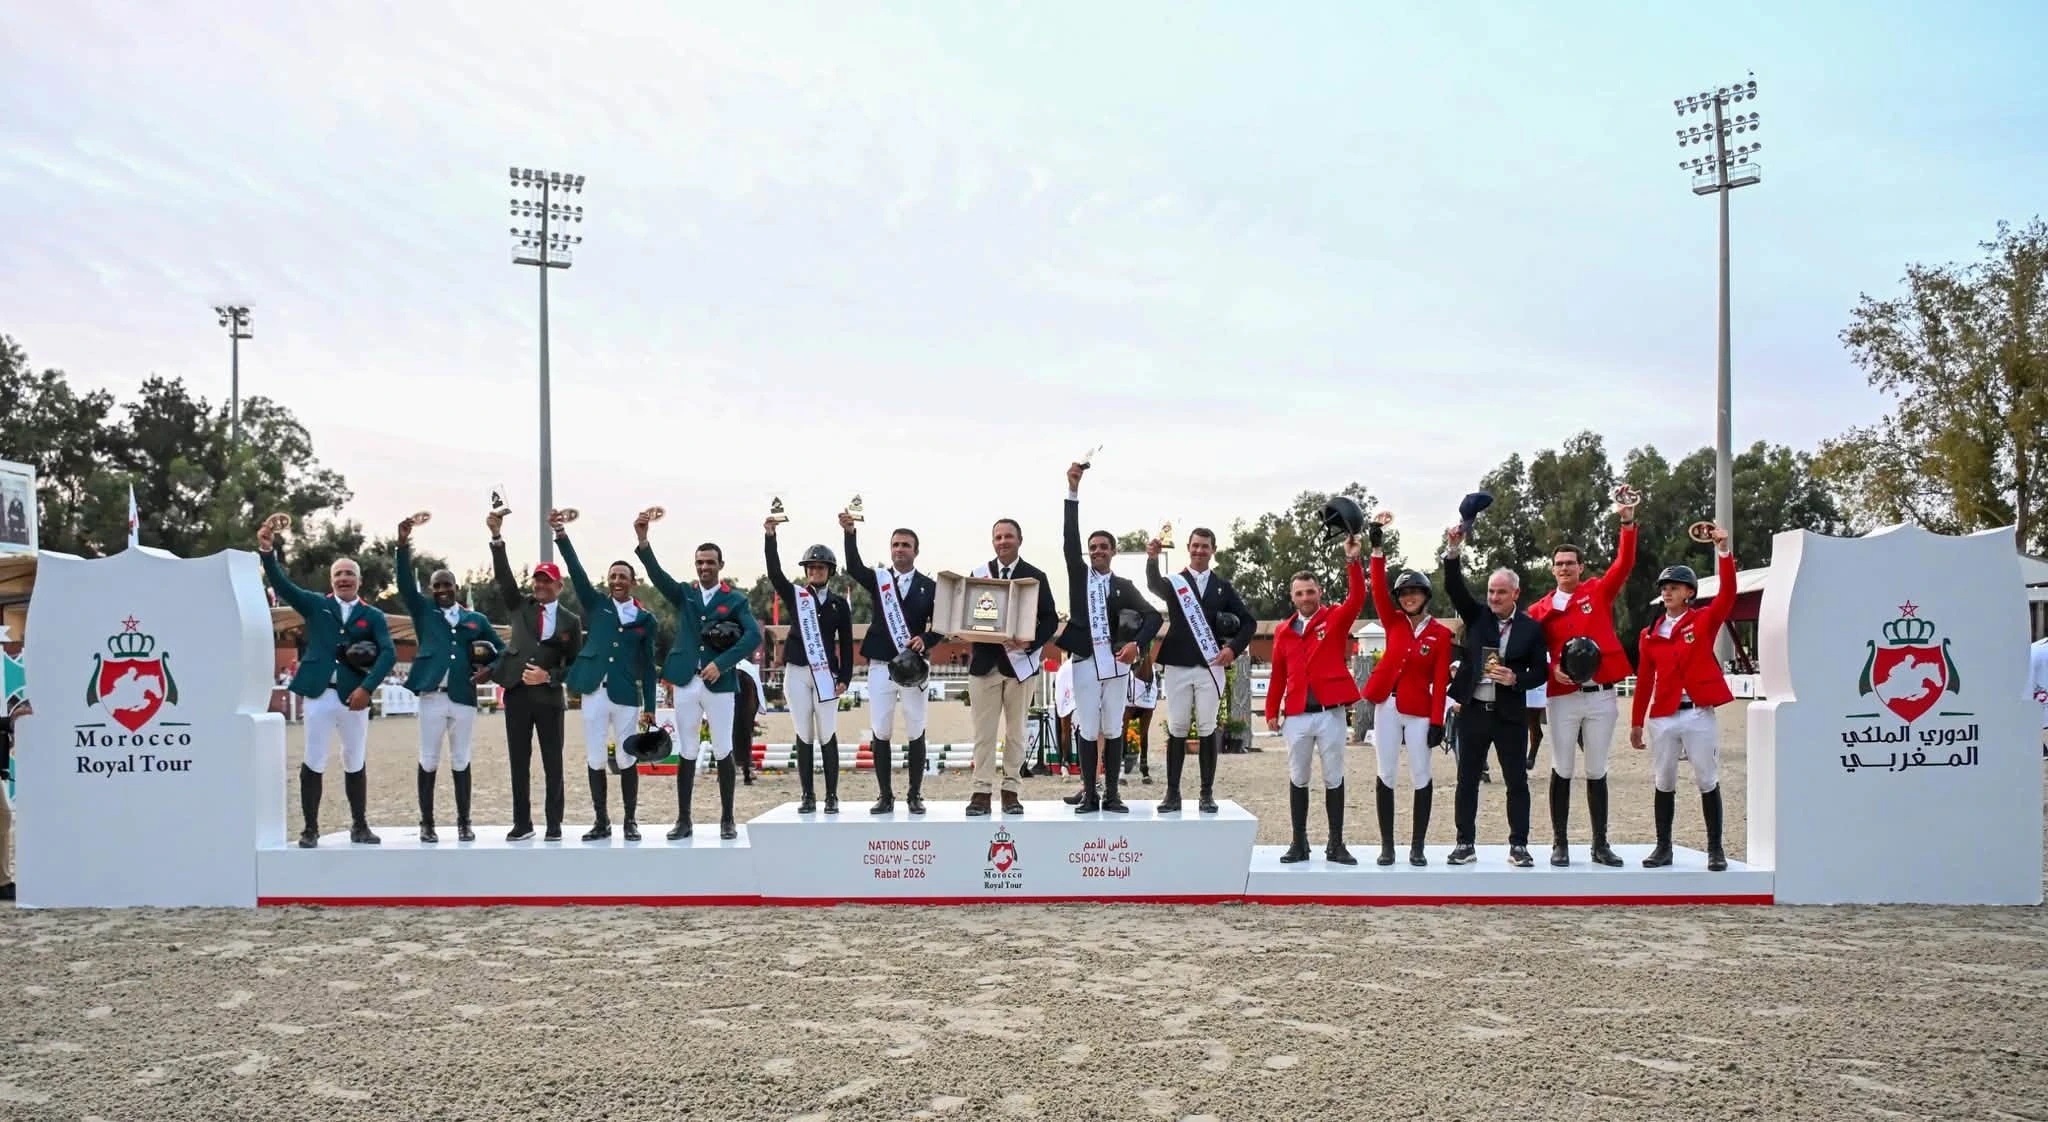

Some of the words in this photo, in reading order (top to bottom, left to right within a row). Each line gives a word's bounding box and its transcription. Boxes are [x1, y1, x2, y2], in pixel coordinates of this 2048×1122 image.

[1188, 614, 1204, 637] Nations
[1199, 638, 1210, 651] Cup
[895, 635, 904, 648] Cup
[807, 642, 816, 656] Cup
[75, 730, 191, 747] Morocco
[1841, 726, 1910, 747] الملكي
[1919, 724, 1978, 746] الدوري
[76, 755, 135, 778] Royal
[140, 755, 192, 772] Tour
[868, 841, 909, 851] NATIONS
[912, 840, 931, 850] CUP
[1108, 835, 1128, 851] كأس
[875, 868, 901, 878] Rabat
[903, 868, 926, 878] 2026
[984, 871, 1023, 879] Morocco
[1082, 867, 1105, 877] 2026
[1108, 867, 1130, 879] الرباط
[984, 881, 1004, 892] Royal
[1005, 881, 1023, 889] Tour
